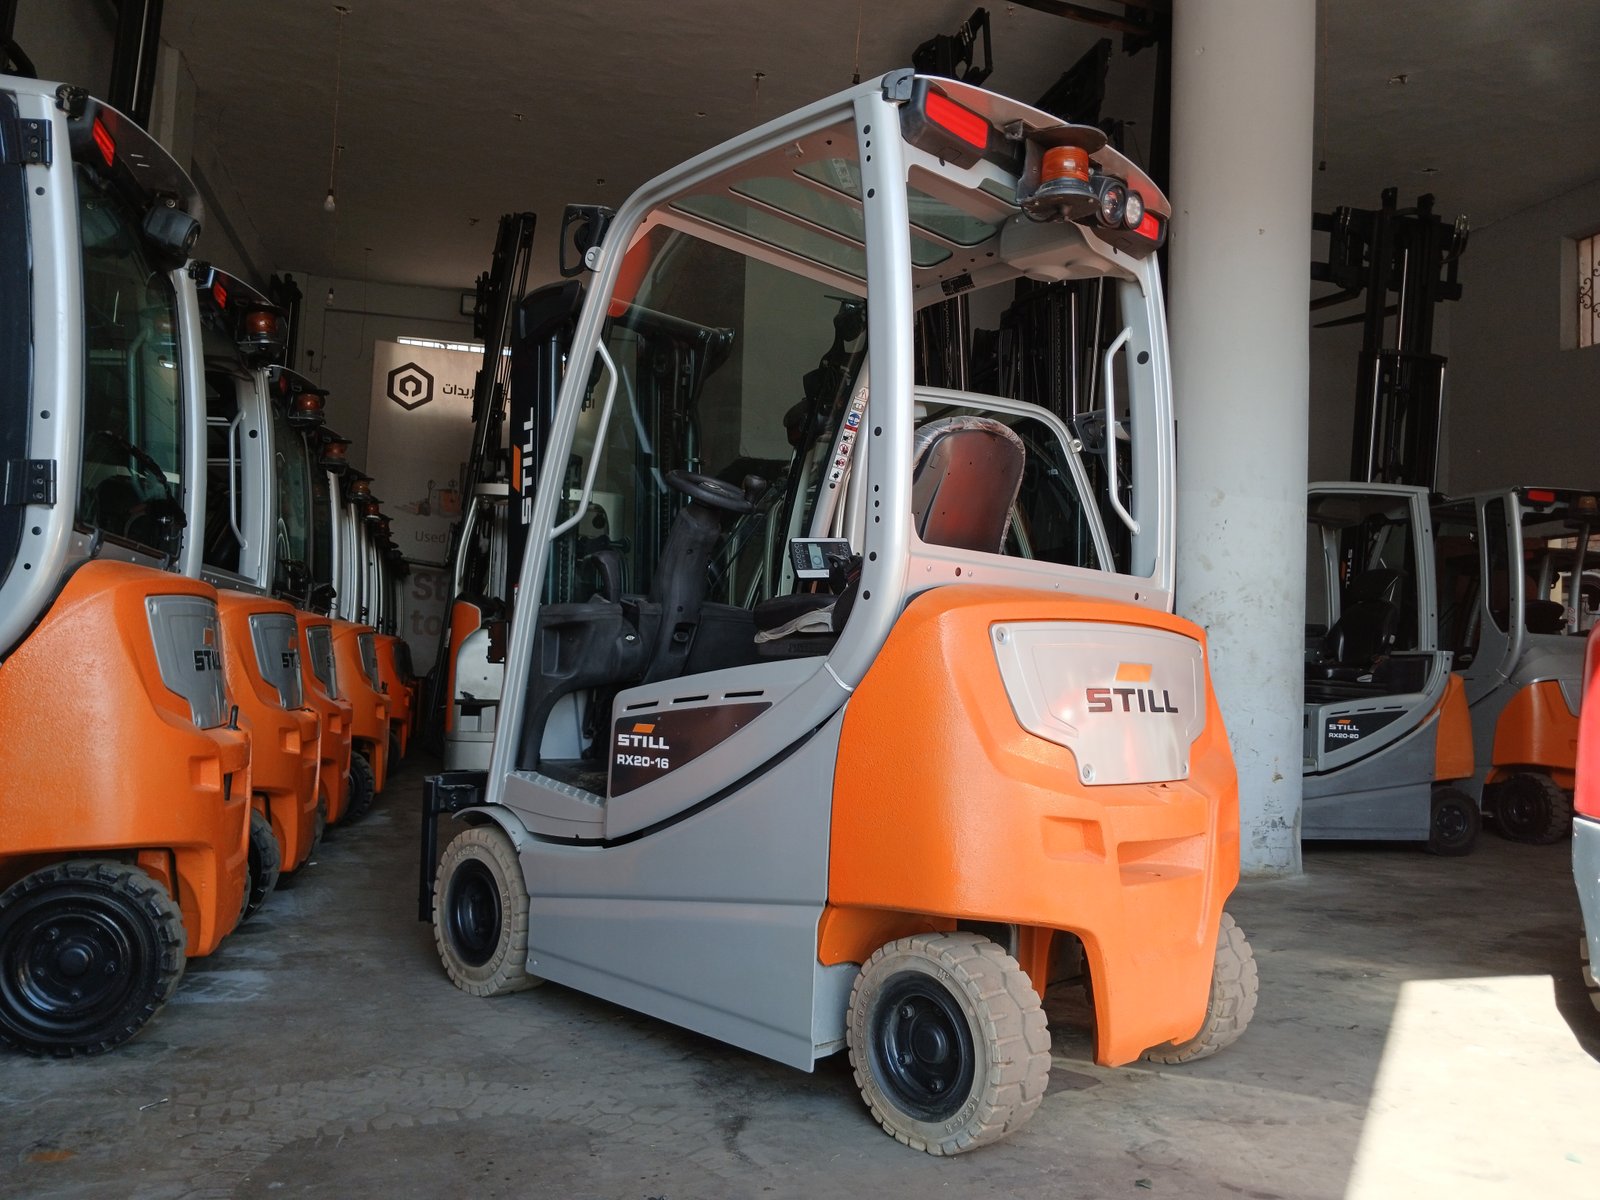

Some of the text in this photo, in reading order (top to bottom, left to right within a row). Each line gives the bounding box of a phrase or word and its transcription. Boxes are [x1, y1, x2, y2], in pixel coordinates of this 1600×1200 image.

[441, 383, 475, 400] ريدات
[521, 407, 534, 525] STILL
[415, 530, 446, 543] Used
[411, 572, 447, 601] St
[410, 609, 441, 636] to
[1086, 687, 1178, 713] STILL
[1329, 723, 1359, 731] STILL
[618, 733, 670, 750] STILL
[617, 753, 669, 769] RX20-16
